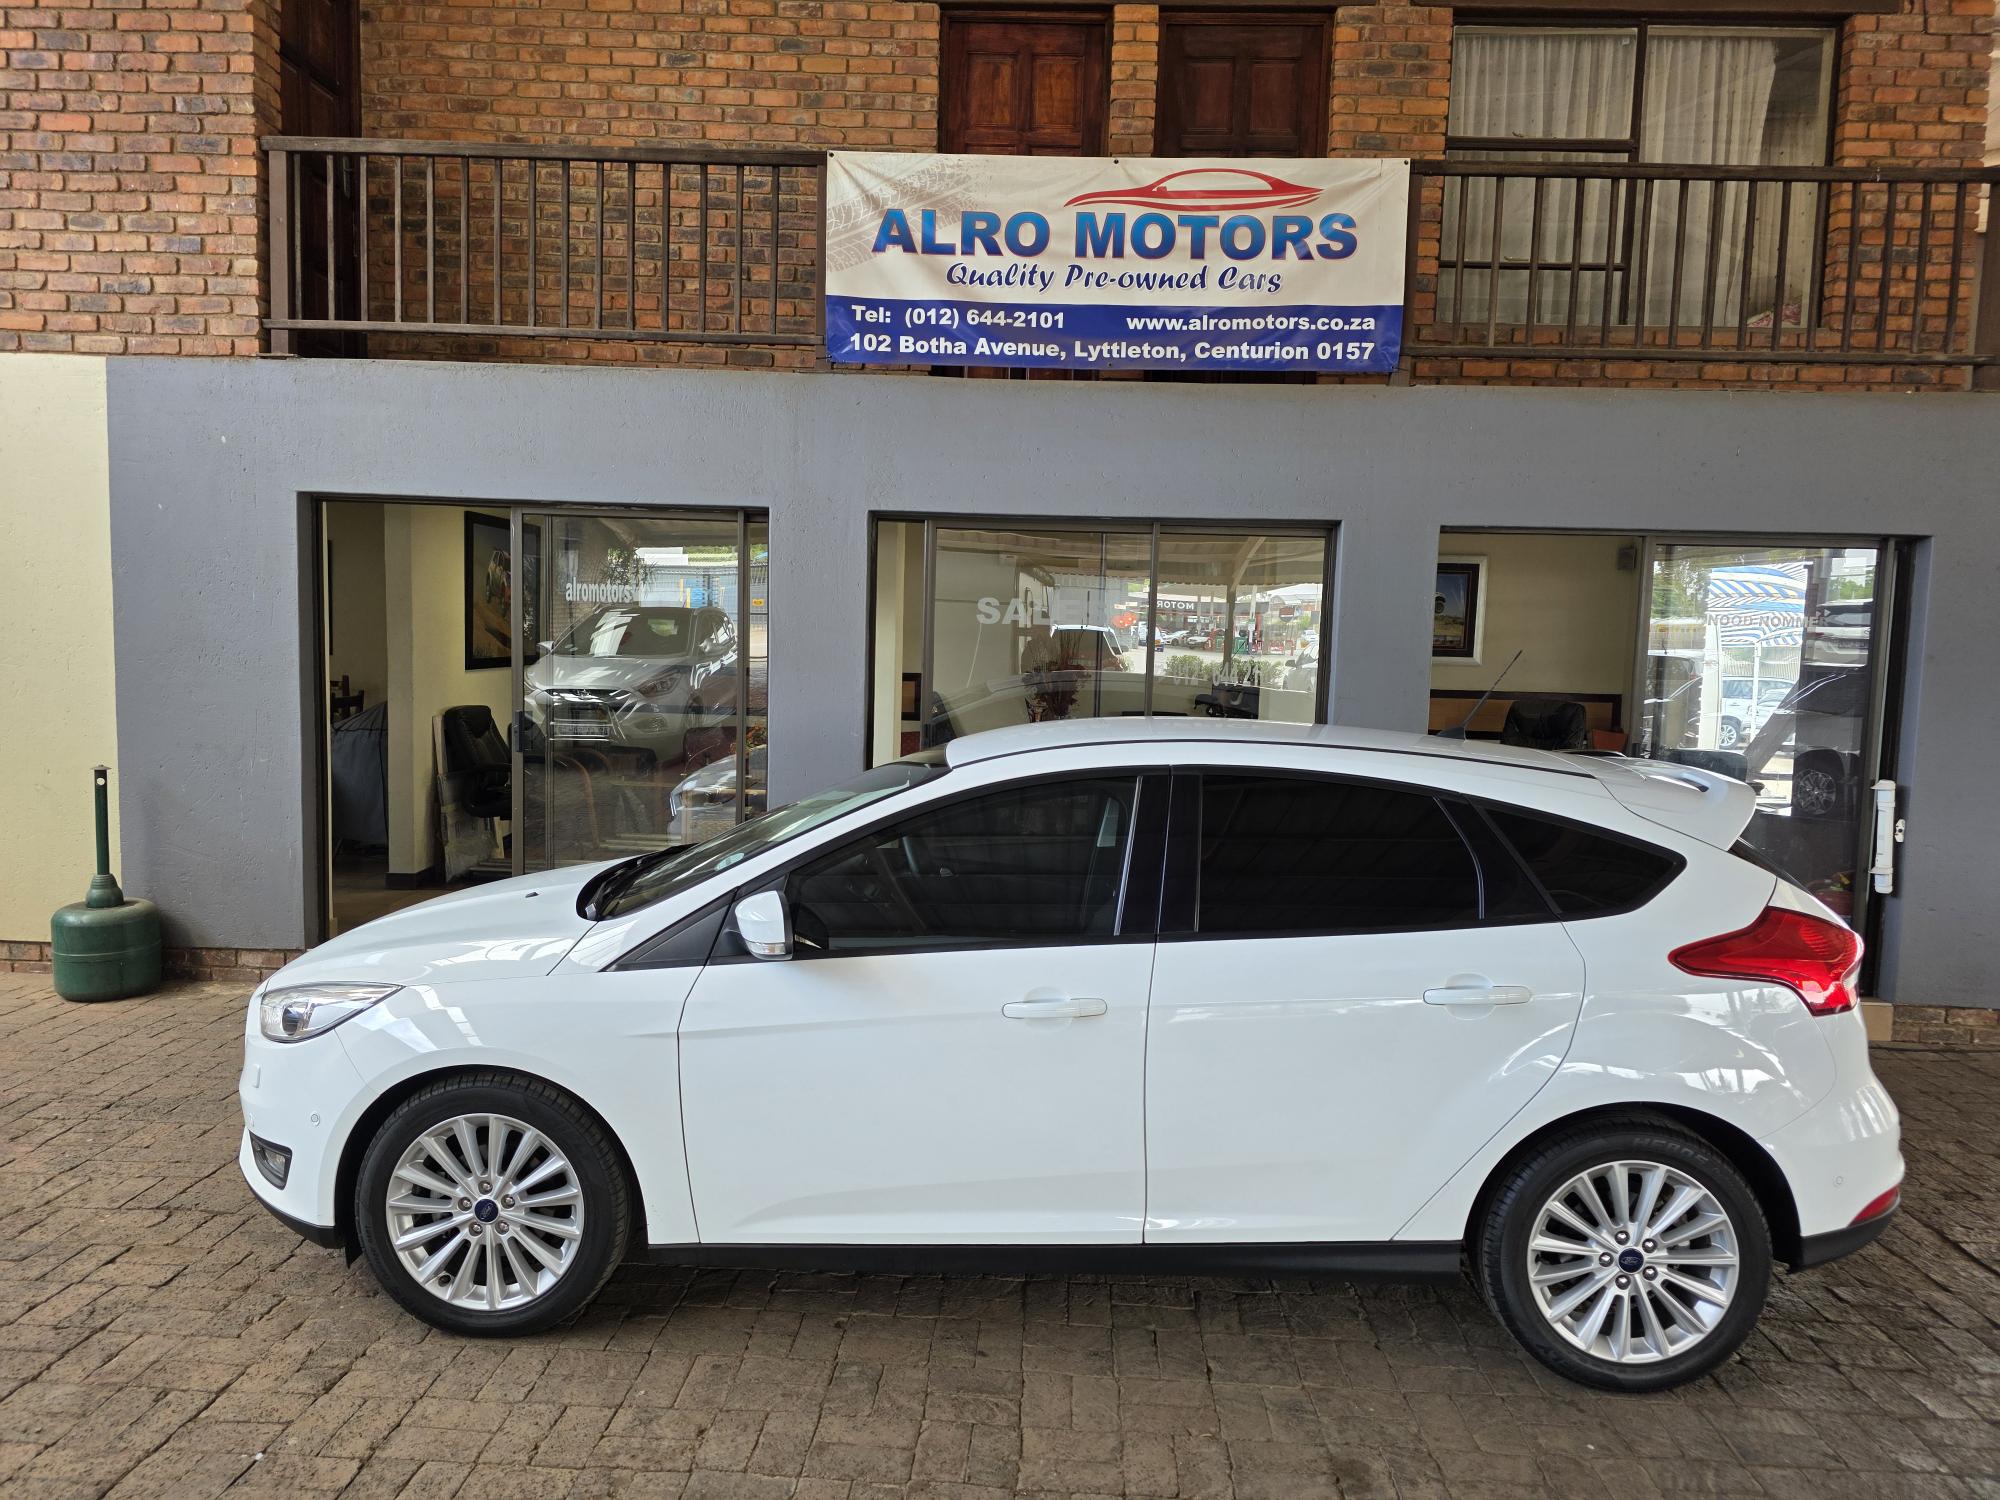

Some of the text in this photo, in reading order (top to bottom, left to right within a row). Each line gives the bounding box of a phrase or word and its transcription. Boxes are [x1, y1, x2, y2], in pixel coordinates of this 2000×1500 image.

[871, 208, 1358, 261] ALRO MOTORS
[946, 262, 1282, 294] Quality Pre-owned Cars
[852, 304, 1064, 329] Tel: (012) 644-2101
[1126, 314, 1376, 331] www.alromotors.co.za
[850, 333, 1375, 362] 102 Botha Avenue, Lyttleton, Centurion 0157
